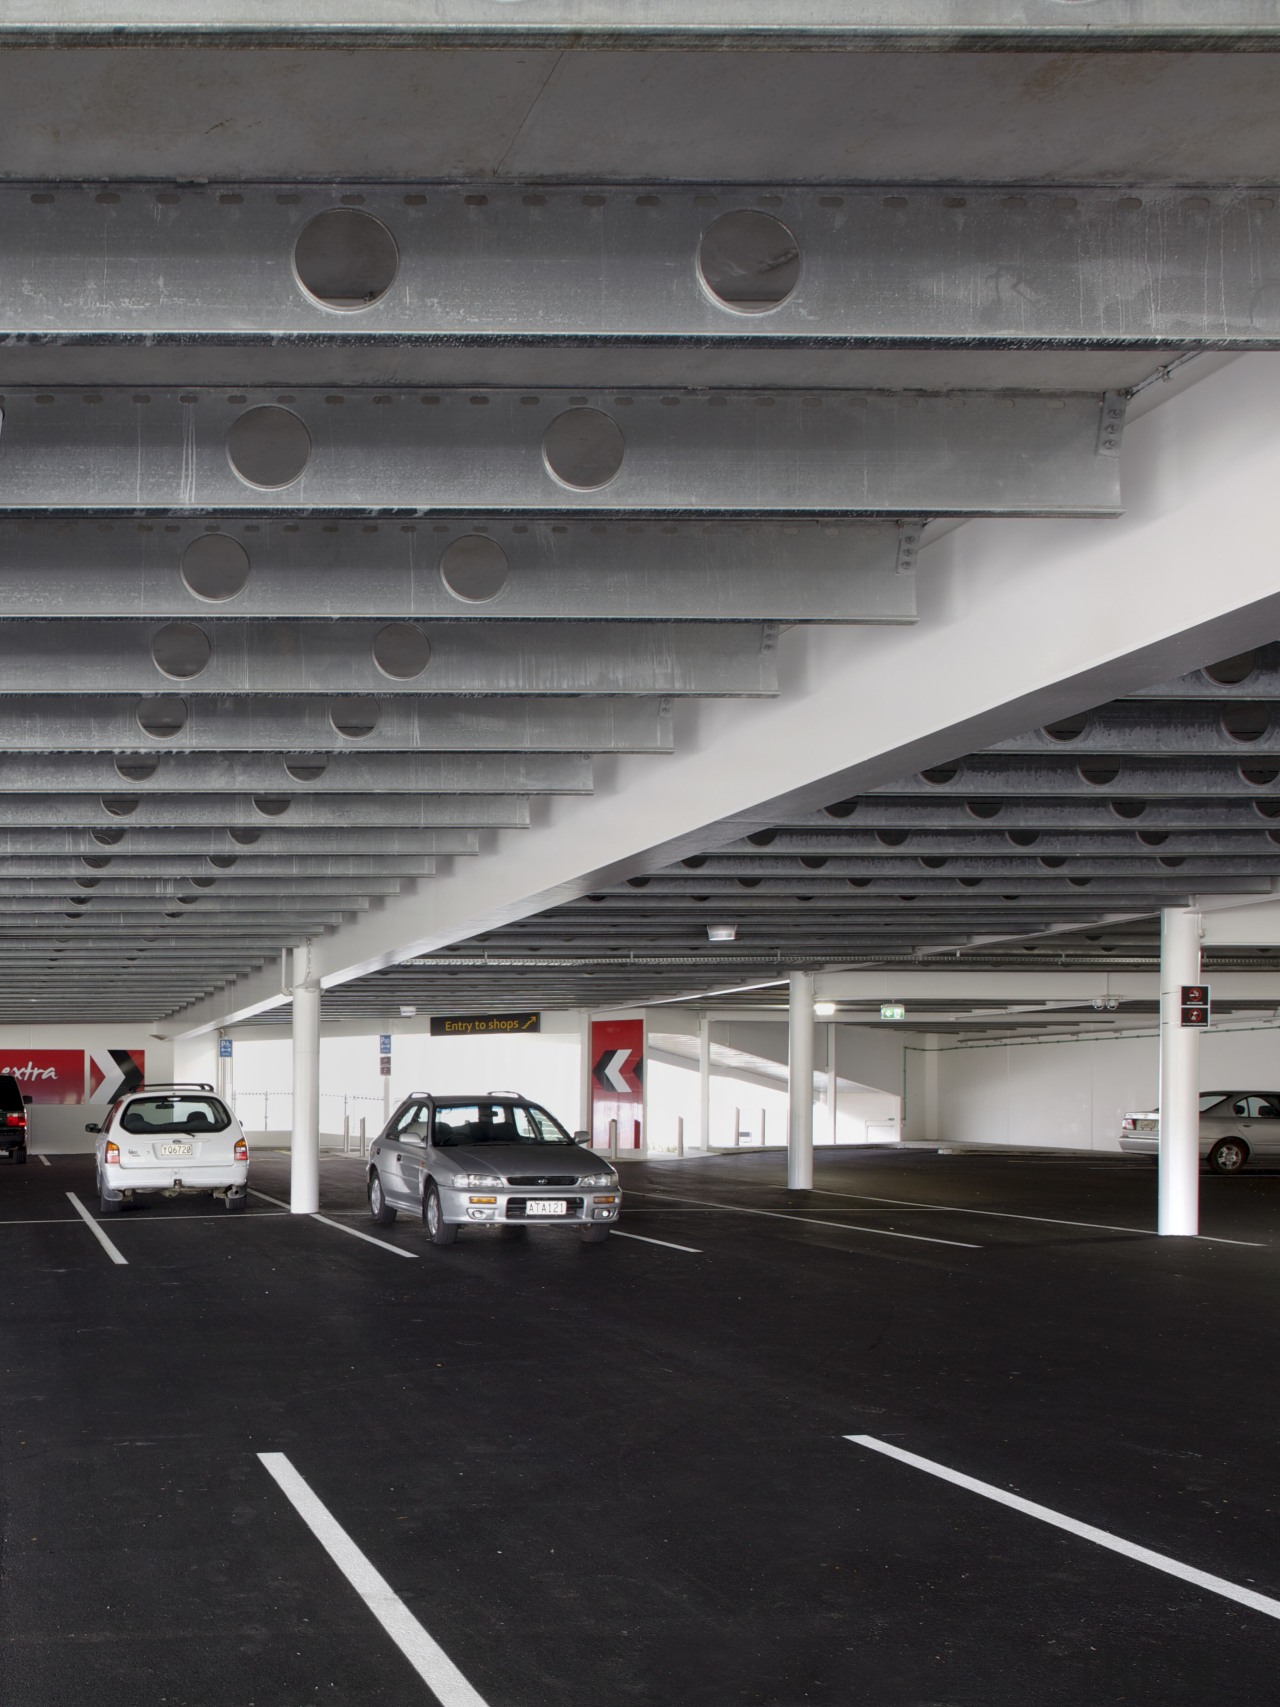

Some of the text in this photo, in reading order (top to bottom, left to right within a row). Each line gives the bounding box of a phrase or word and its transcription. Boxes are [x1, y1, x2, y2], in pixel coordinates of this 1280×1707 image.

[445, 1019, 519, 1033] Entry to shops
[1, 1061, 59, 1081] extra
[162, 1144, 192, 1155] YQ6720
[528, 1202, 564, 1213] ATA121
